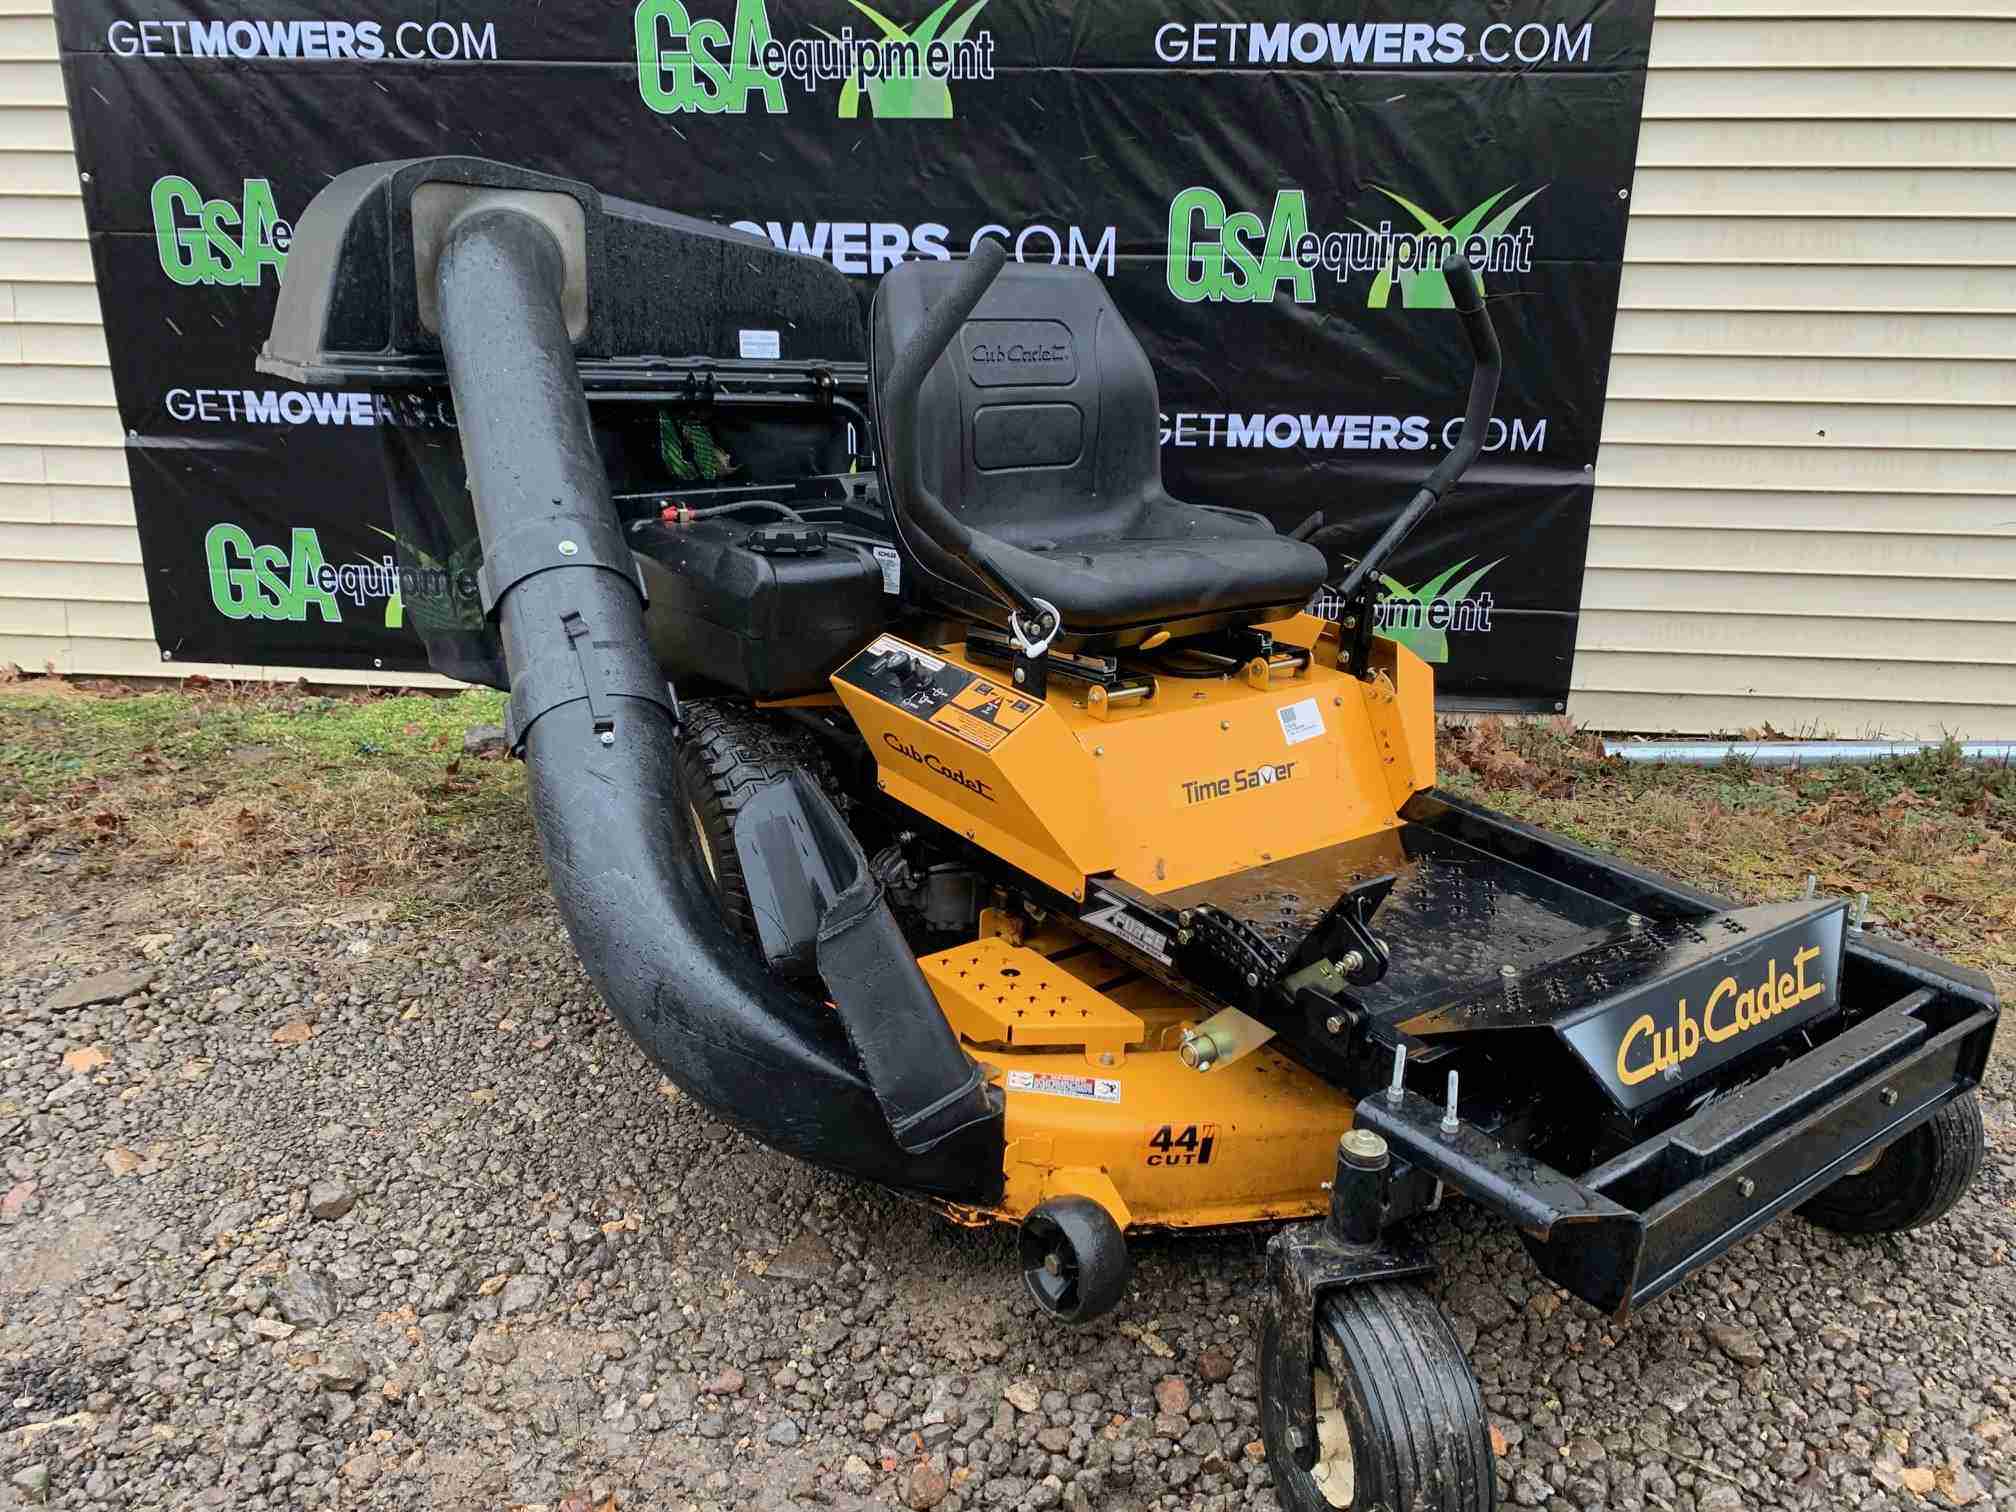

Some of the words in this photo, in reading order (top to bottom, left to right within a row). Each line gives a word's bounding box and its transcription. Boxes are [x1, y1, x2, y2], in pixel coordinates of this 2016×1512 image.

[107, 20, 498, 60] GETMOWERS.COM
[762, 27, 994, 92] equipment
[1154, 23, 1592, 63] GETMOWERS.COM
[1294, 221, 1534, 283] equipment
[1181, 778, 1231, 804] Time
[1233, 761, 1296, 793] Saver
[1616, 998, 1700, 1086] Cub
[1703, 945, 1822, 1044] Cadet
[1147, 1154, 1197, 1166] CUT
